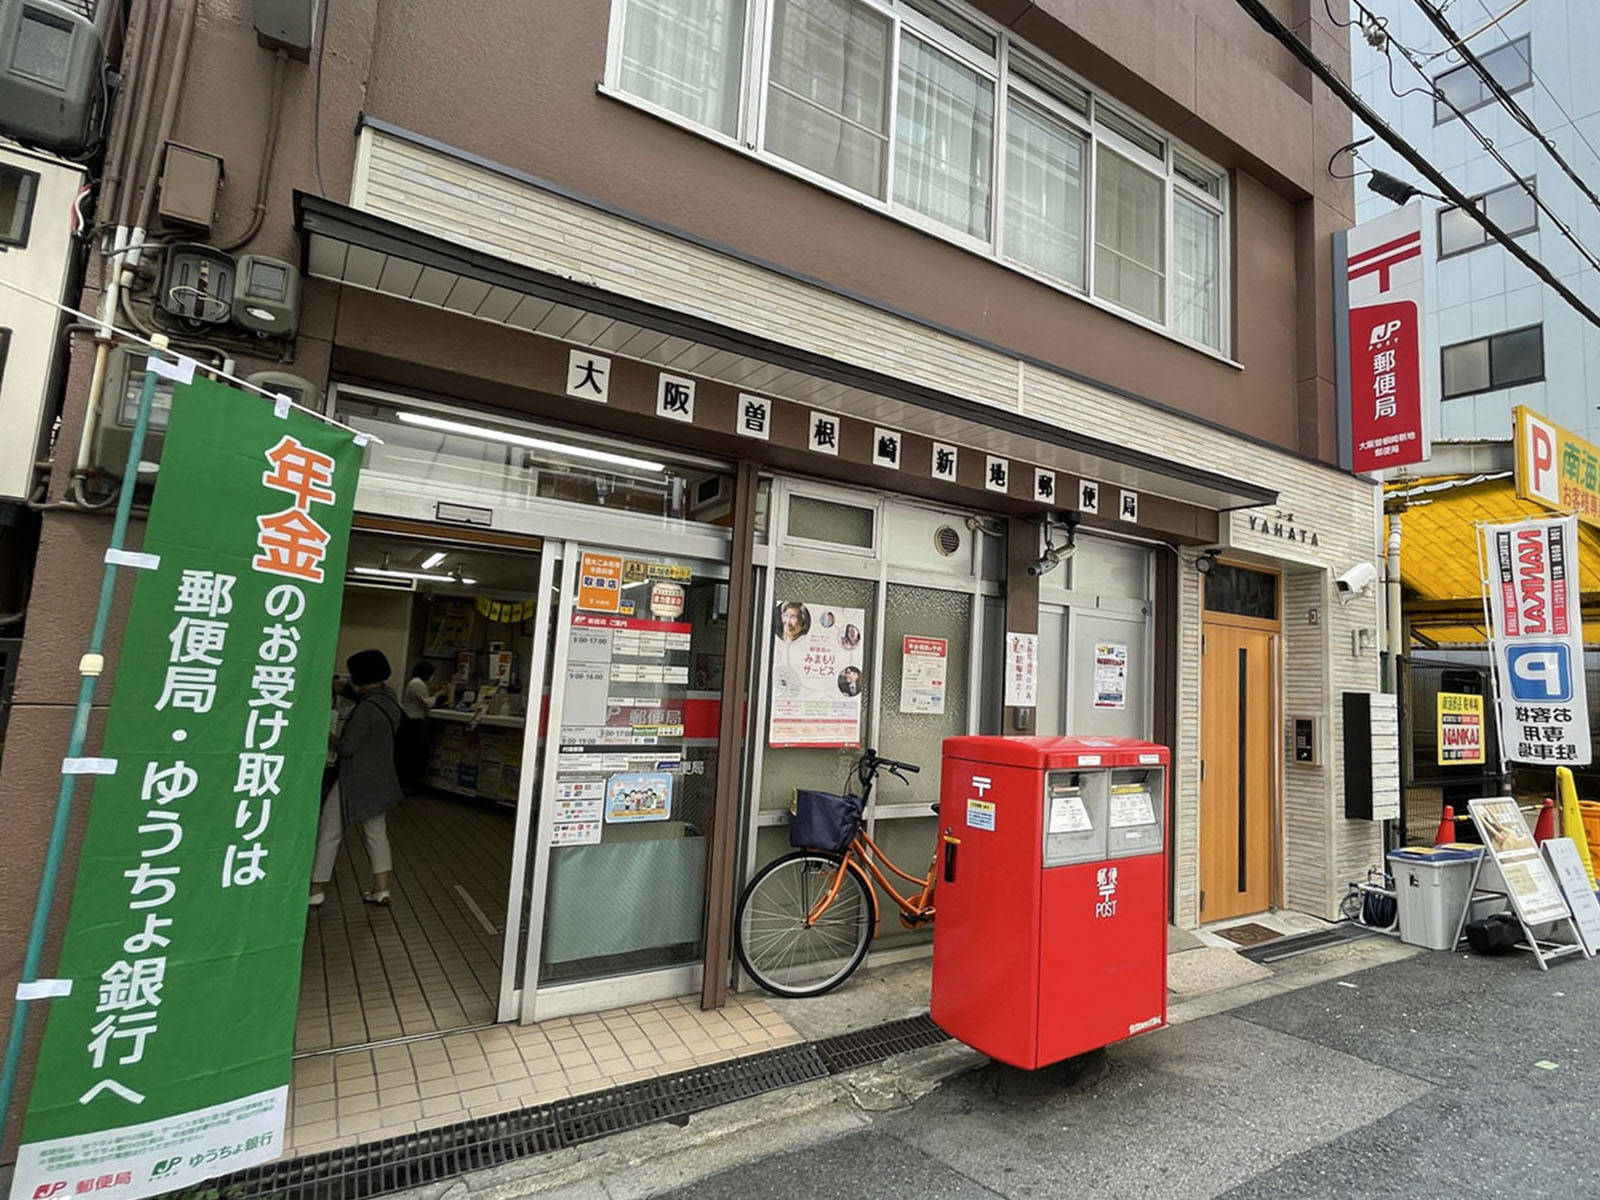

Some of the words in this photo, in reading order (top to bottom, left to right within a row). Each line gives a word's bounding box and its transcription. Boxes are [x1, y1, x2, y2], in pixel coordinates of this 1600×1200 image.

[1373, 349, 1397, 421] 郵便局
[574, 360, 1137, 518] 大阪曽根崎新地郵便局
[1532, 423, 1552, 492] P
[1249, 516, 1319, 547] YAHATA
[222, 434, 337, 888] 年金のお受け取りは
[803, 665, 836, 676] サービス
[804, 653, 836, 665] みまもり
[78, 569, 237, 1105] 郵便局・ゆうちょ銀行へ
[1096, 868, 1118, 888] 郵便
[1095, 901, 1117, 919] POST
[189, 1131, 275, 1169] ゆうちょ銀行
[75, 1171, 133, 1195] 郵便局
